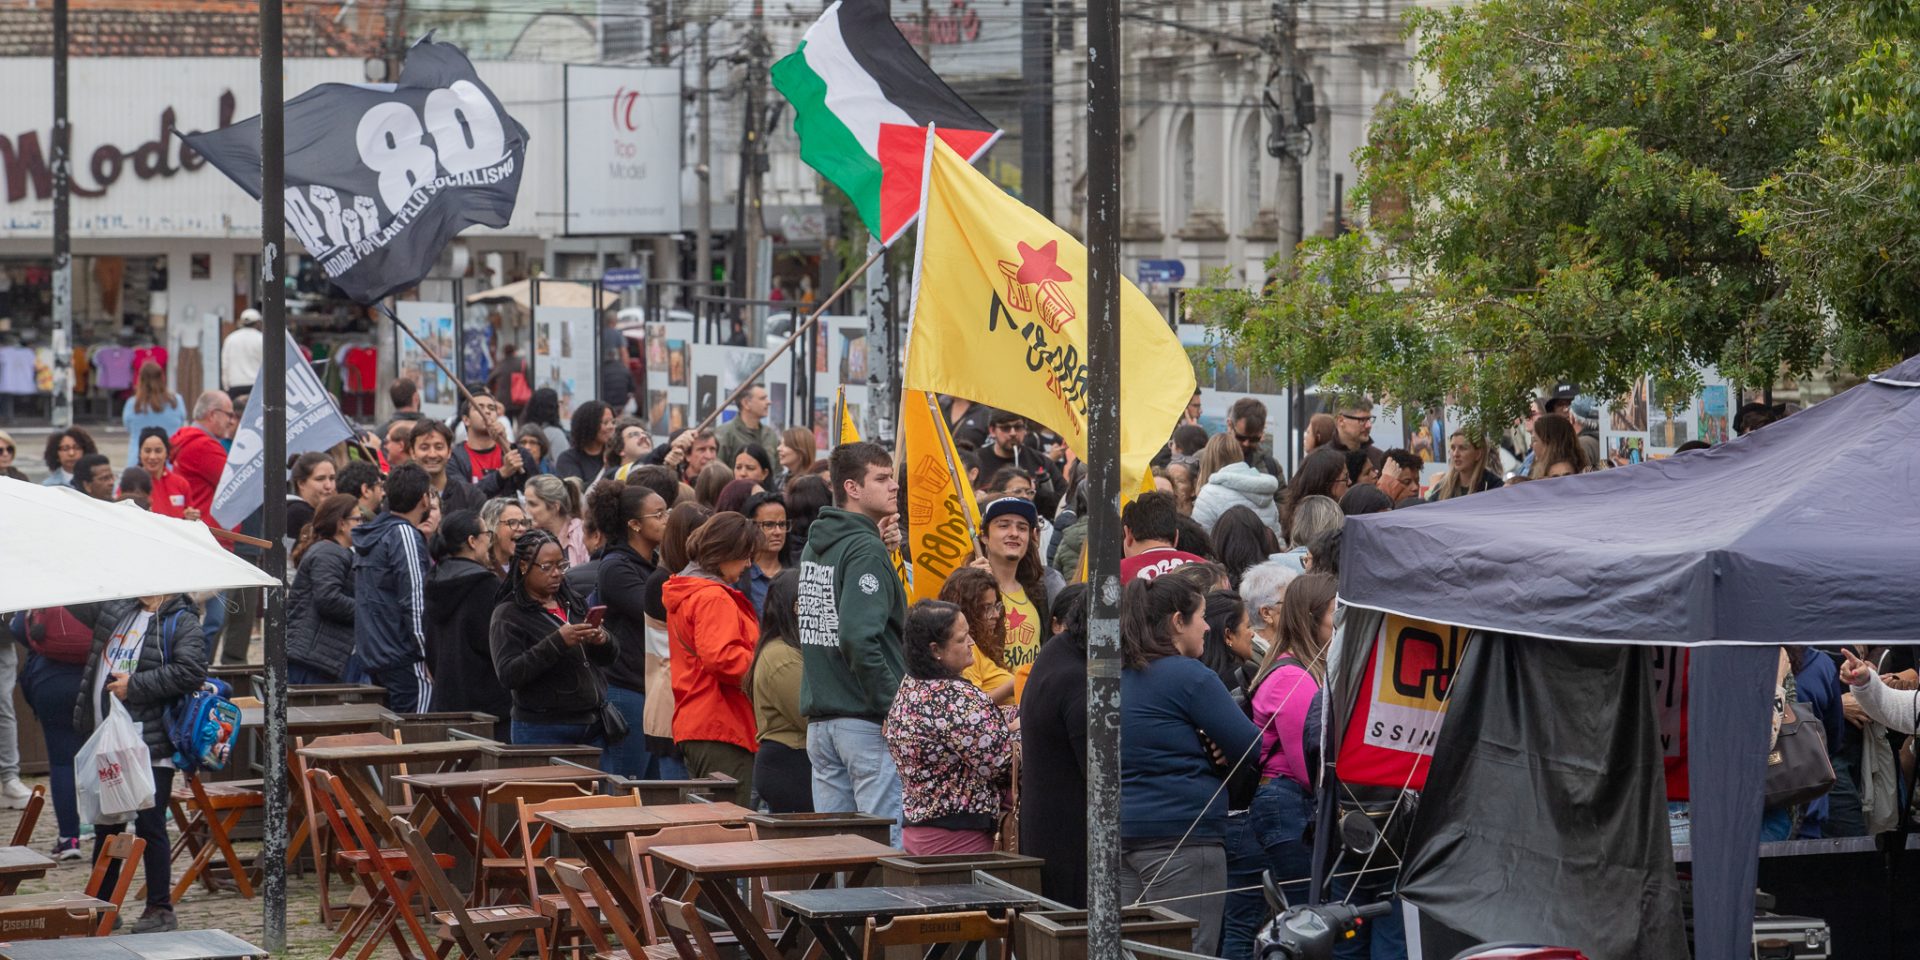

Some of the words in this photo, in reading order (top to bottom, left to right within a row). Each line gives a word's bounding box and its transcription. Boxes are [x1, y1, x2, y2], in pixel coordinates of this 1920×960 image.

[356, 79, 506, 216] 80
[613, 139, 637, 159] Top
[609, 161, 646, 180] Model
[398, 188, 430, 226] PELO
[428, 156, 514, 196] SOCIALISMO
[1046, 369, 1062, 400] 20
[1371, 721, 1436, 746] SSIN
